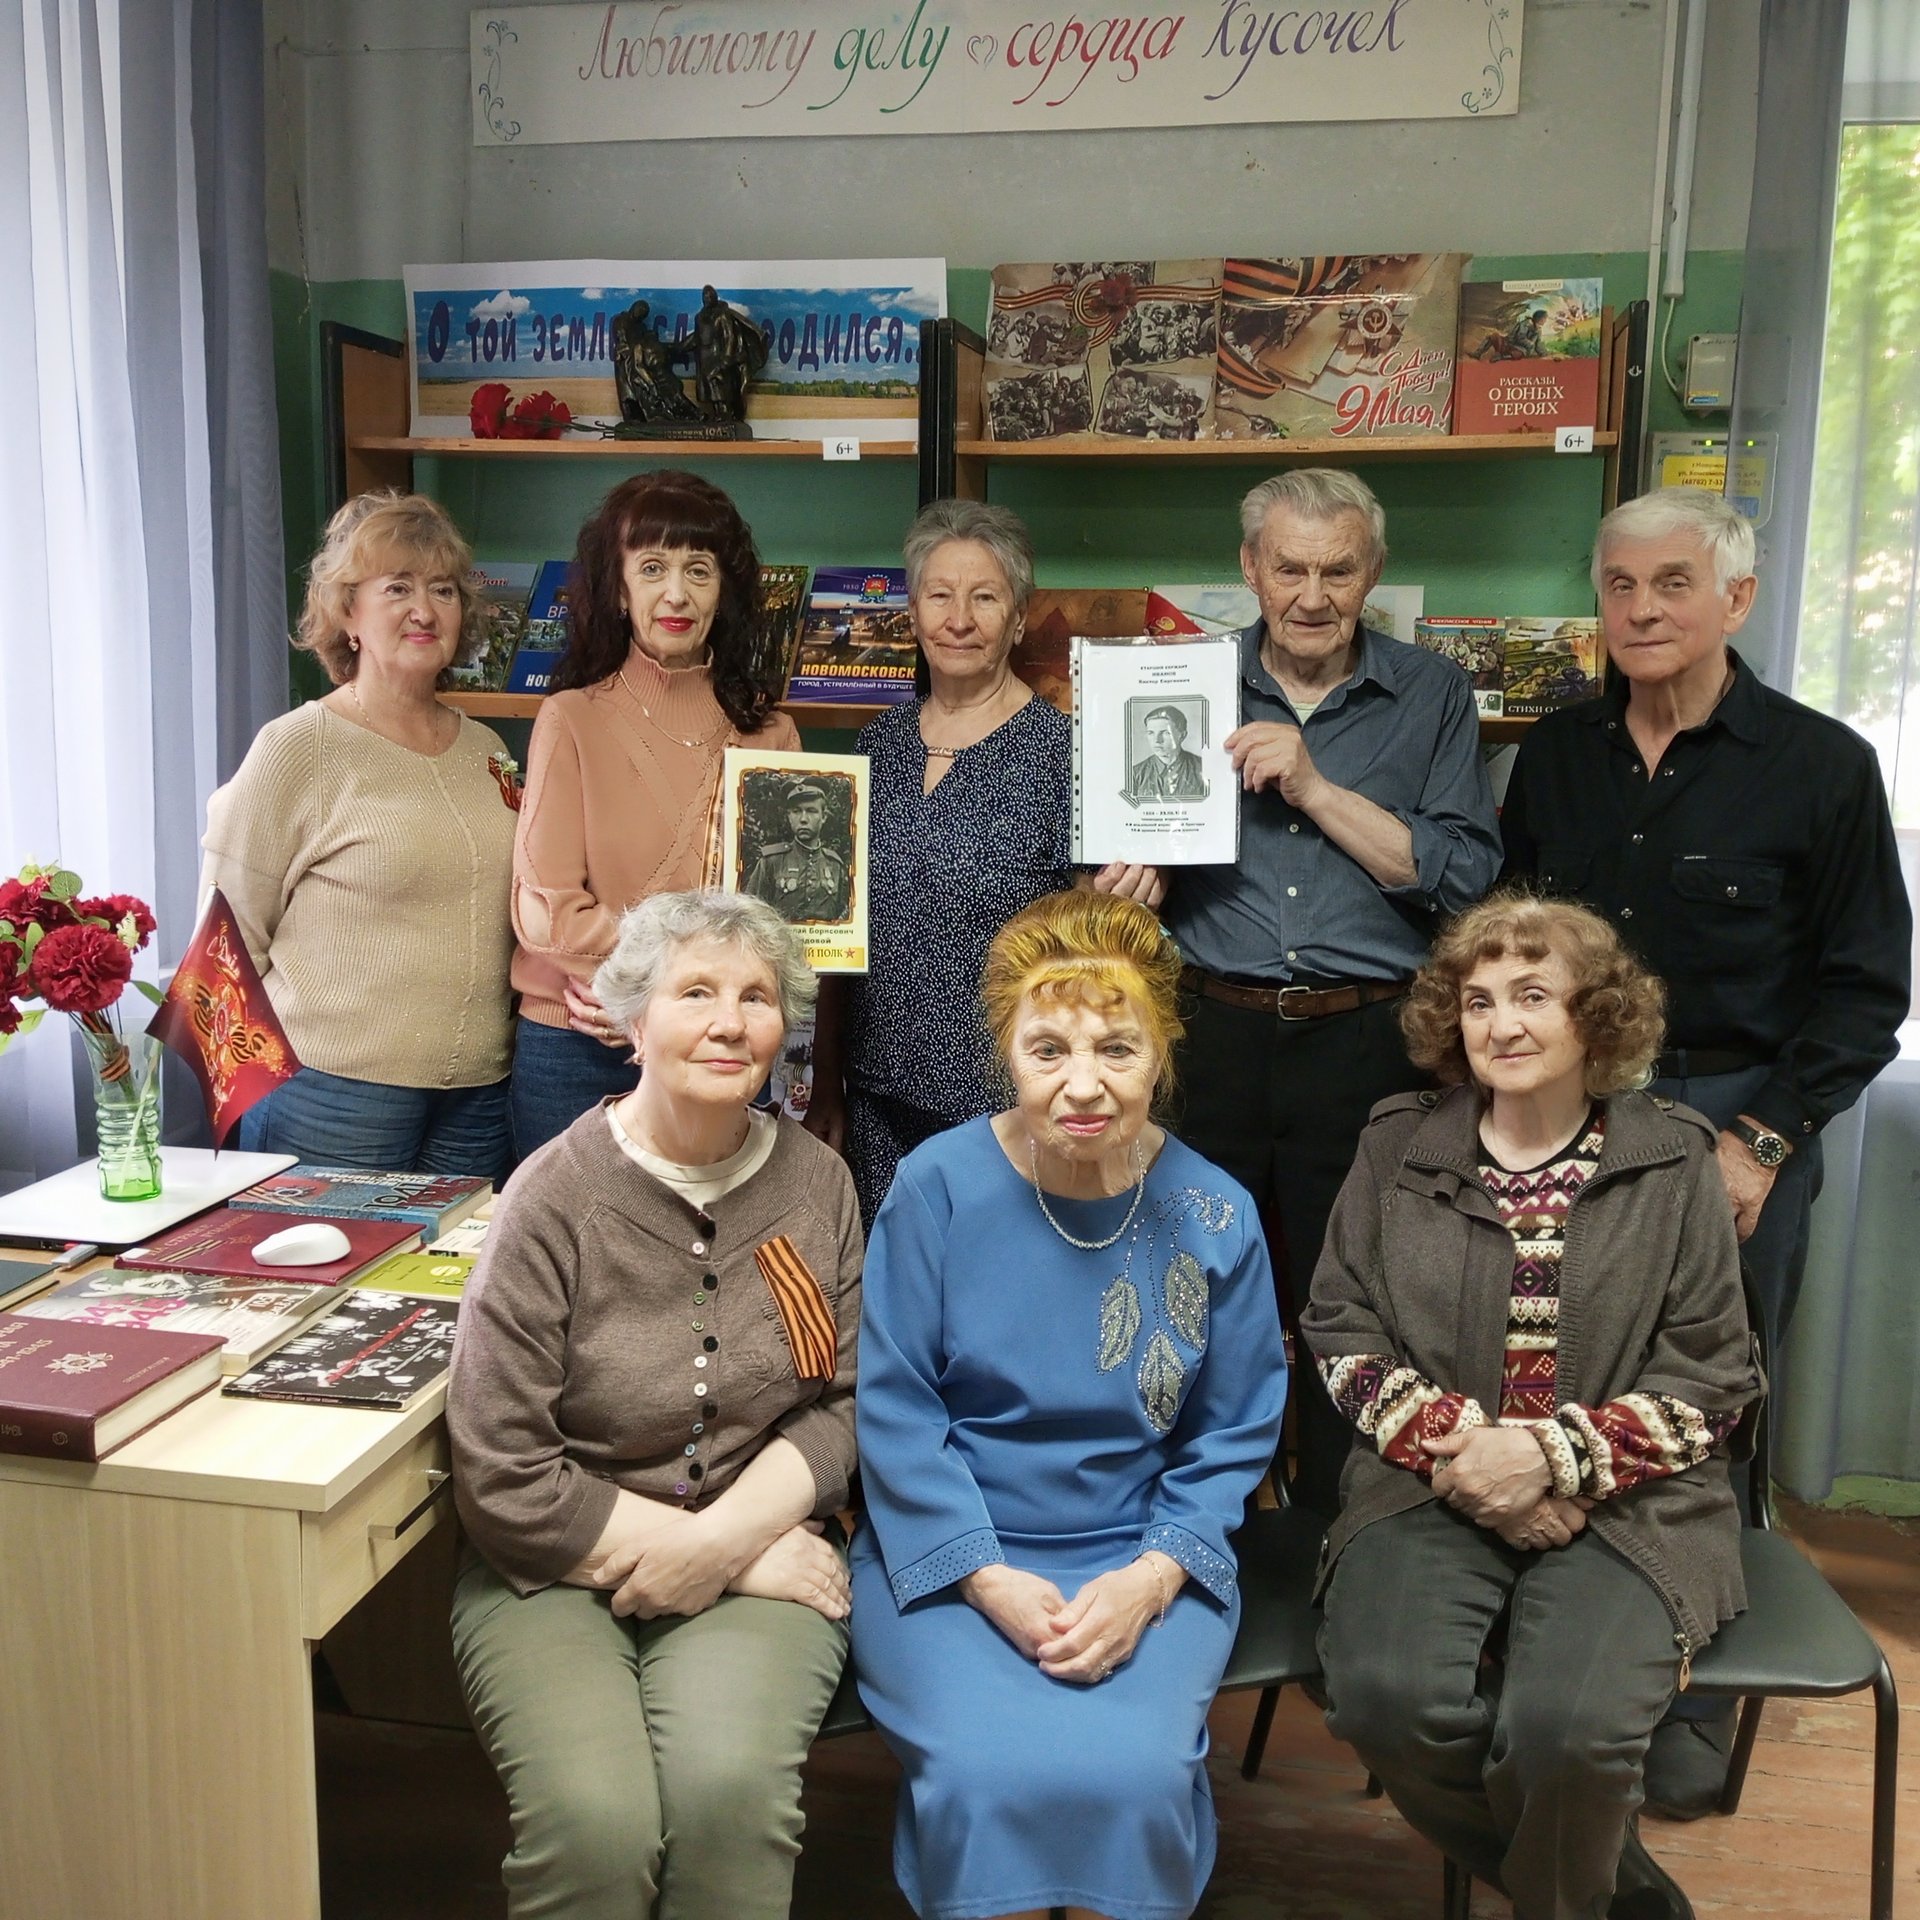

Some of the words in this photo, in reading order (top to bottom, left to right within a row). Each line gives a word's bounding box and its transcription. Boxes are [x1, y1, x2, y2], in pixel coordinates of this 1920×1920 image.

[578, 2, 818, 109] Любимому
[806, 0, 951, 114] делу
[1006, 15, 1186, 107] сердца
[428, 299, 450, 364] О
[465, 310, 517, 364] ТОЙ
[1390, 358, 1452, 395] Победы!
[1499, 376, 1557, 387] РАССКАЗЫ
[1488, 387, 1502, 401] О
[1506, 386, 1565, 401] ЮНЫХ
[1330, 384, 1372, 437] 9
[1493, 401, 1559, 416] ГЕРОЯХ
[1563, 433, 1585, 449] 6+
[835, 442, 854, 456] 6+
[800, 664, 916, 679] НОВОМОСКОВСК
[1508, 705, 1543, 713] СТИХИ
[1545, 706, 1554, 714] О
[809, 927, 854, 936] Борисович
[817, 947, 843, 958] ПОЛК
